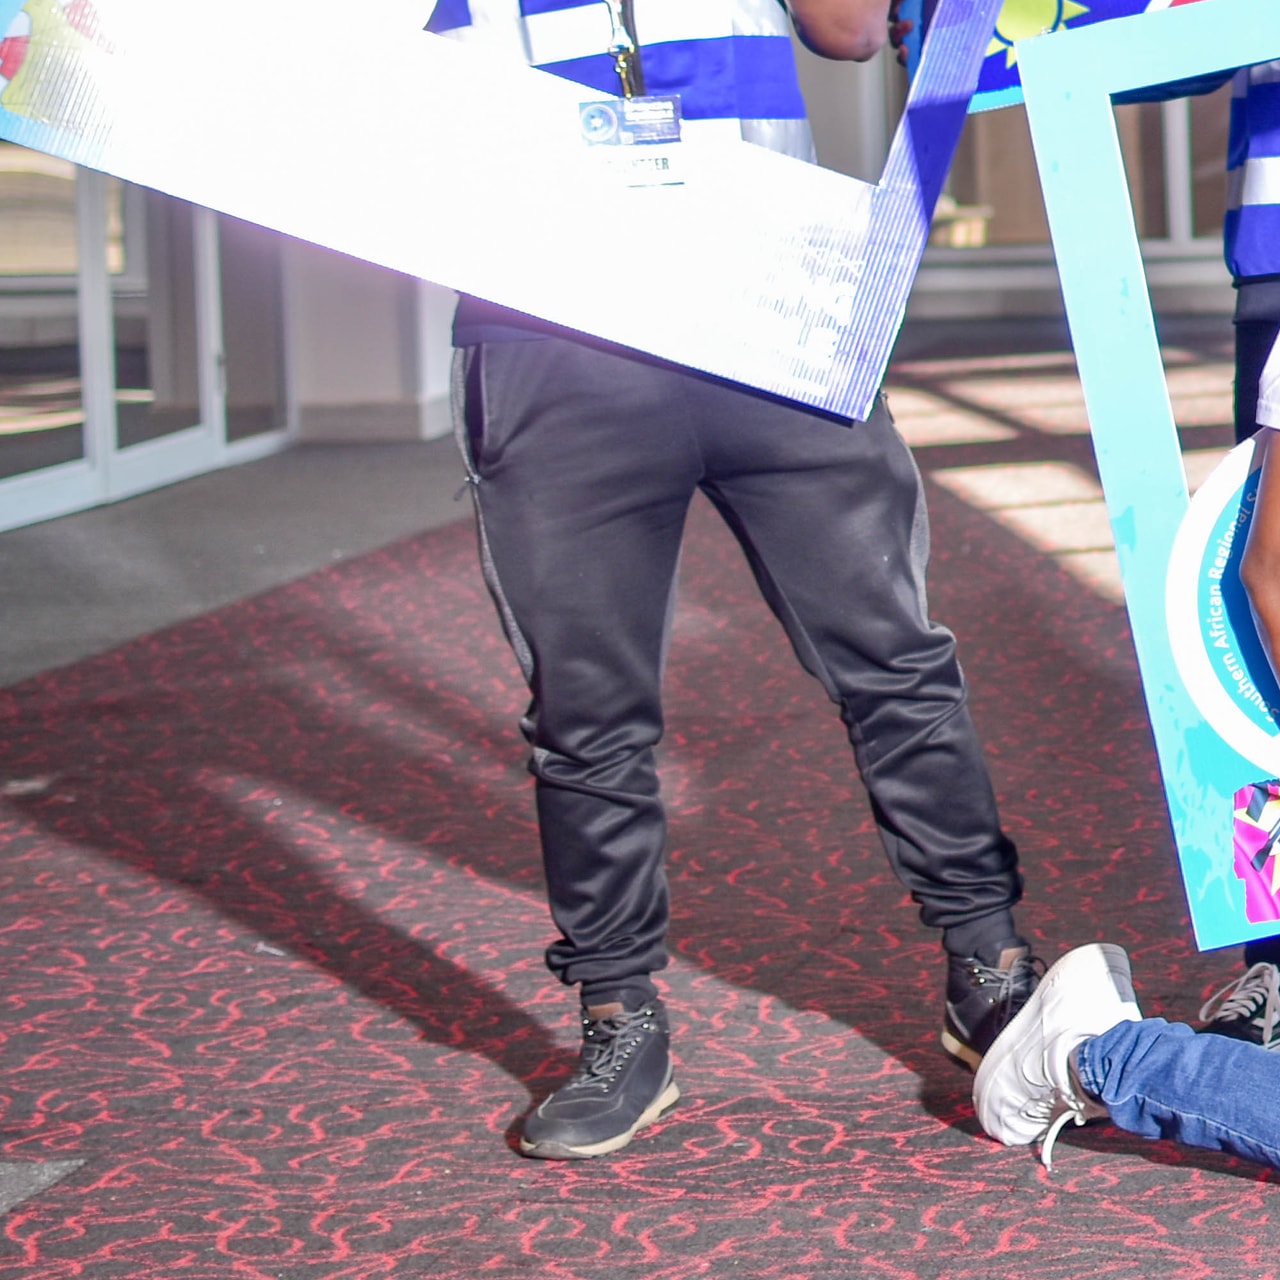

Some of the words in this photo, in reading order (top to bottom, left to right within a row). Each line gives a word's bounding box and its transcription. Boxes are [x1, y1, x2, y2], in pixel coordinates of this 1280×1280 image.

[1208, 507, 1252, 579] Regional
[1208, 588, 1228, 648] African
[1223, 646, 1280, 722] Southern
